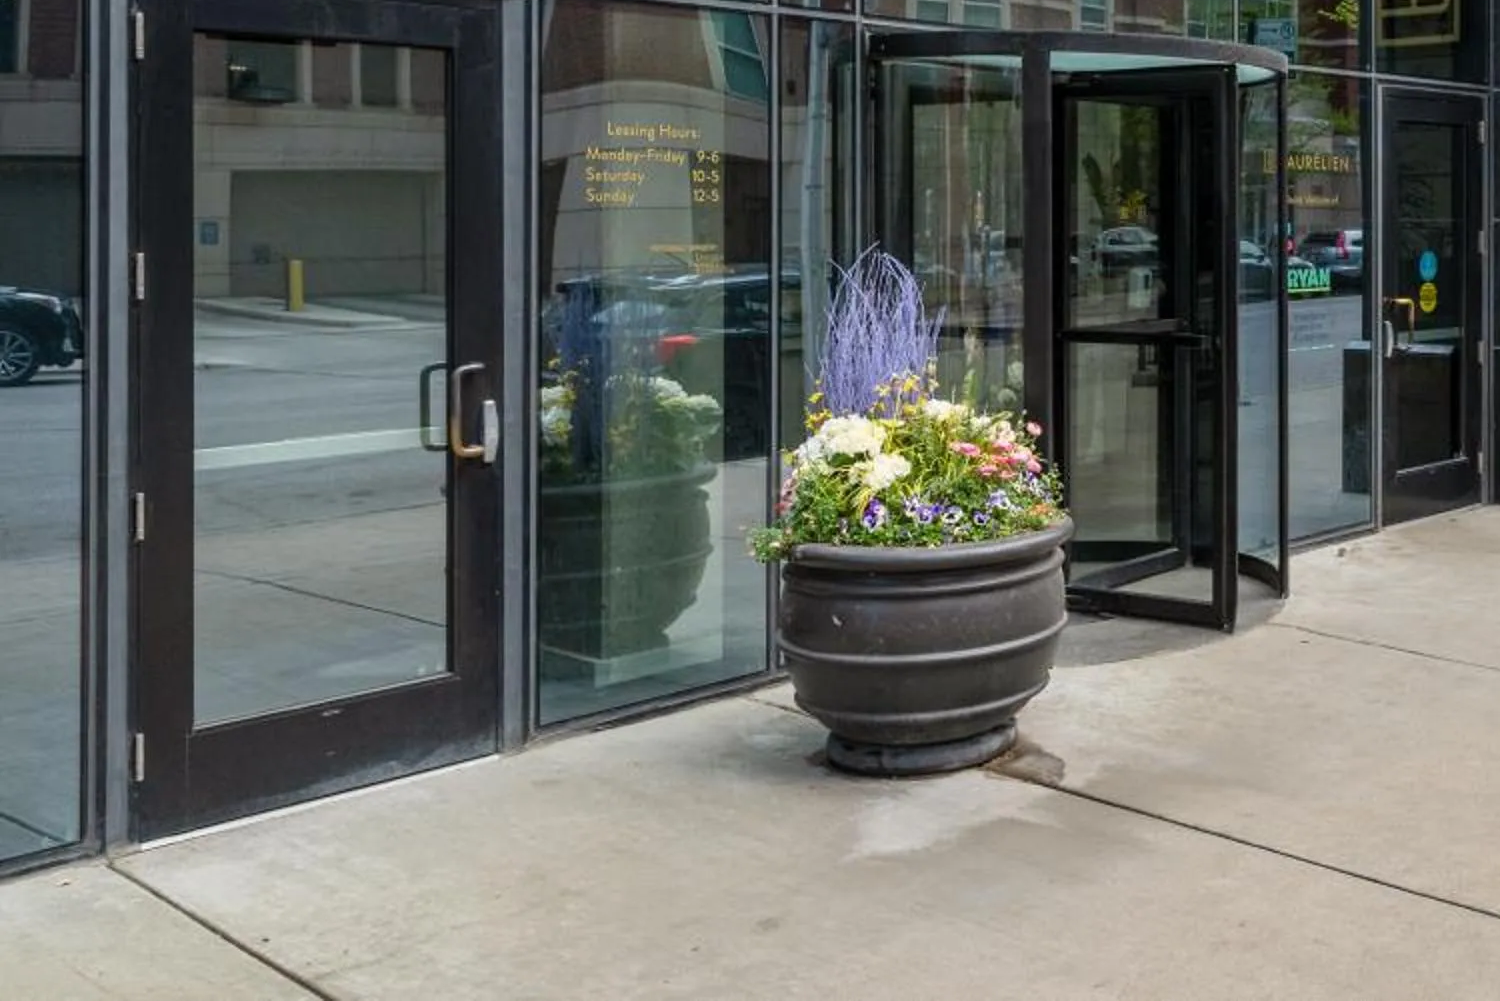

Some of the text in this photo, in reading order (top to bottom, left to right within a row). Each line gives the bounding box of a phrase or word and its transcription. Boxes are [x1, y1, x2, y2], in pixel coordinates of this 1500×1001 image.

[606, 120, 655, 141] Leasing
[696, 150, 719, 164] 9-6
[1286, 153, 1350, 173] AURÉLIEN
[584, 166, 720, 184] Saturday 10-5
[584, 188, 720, 206] Sunday 12-5
